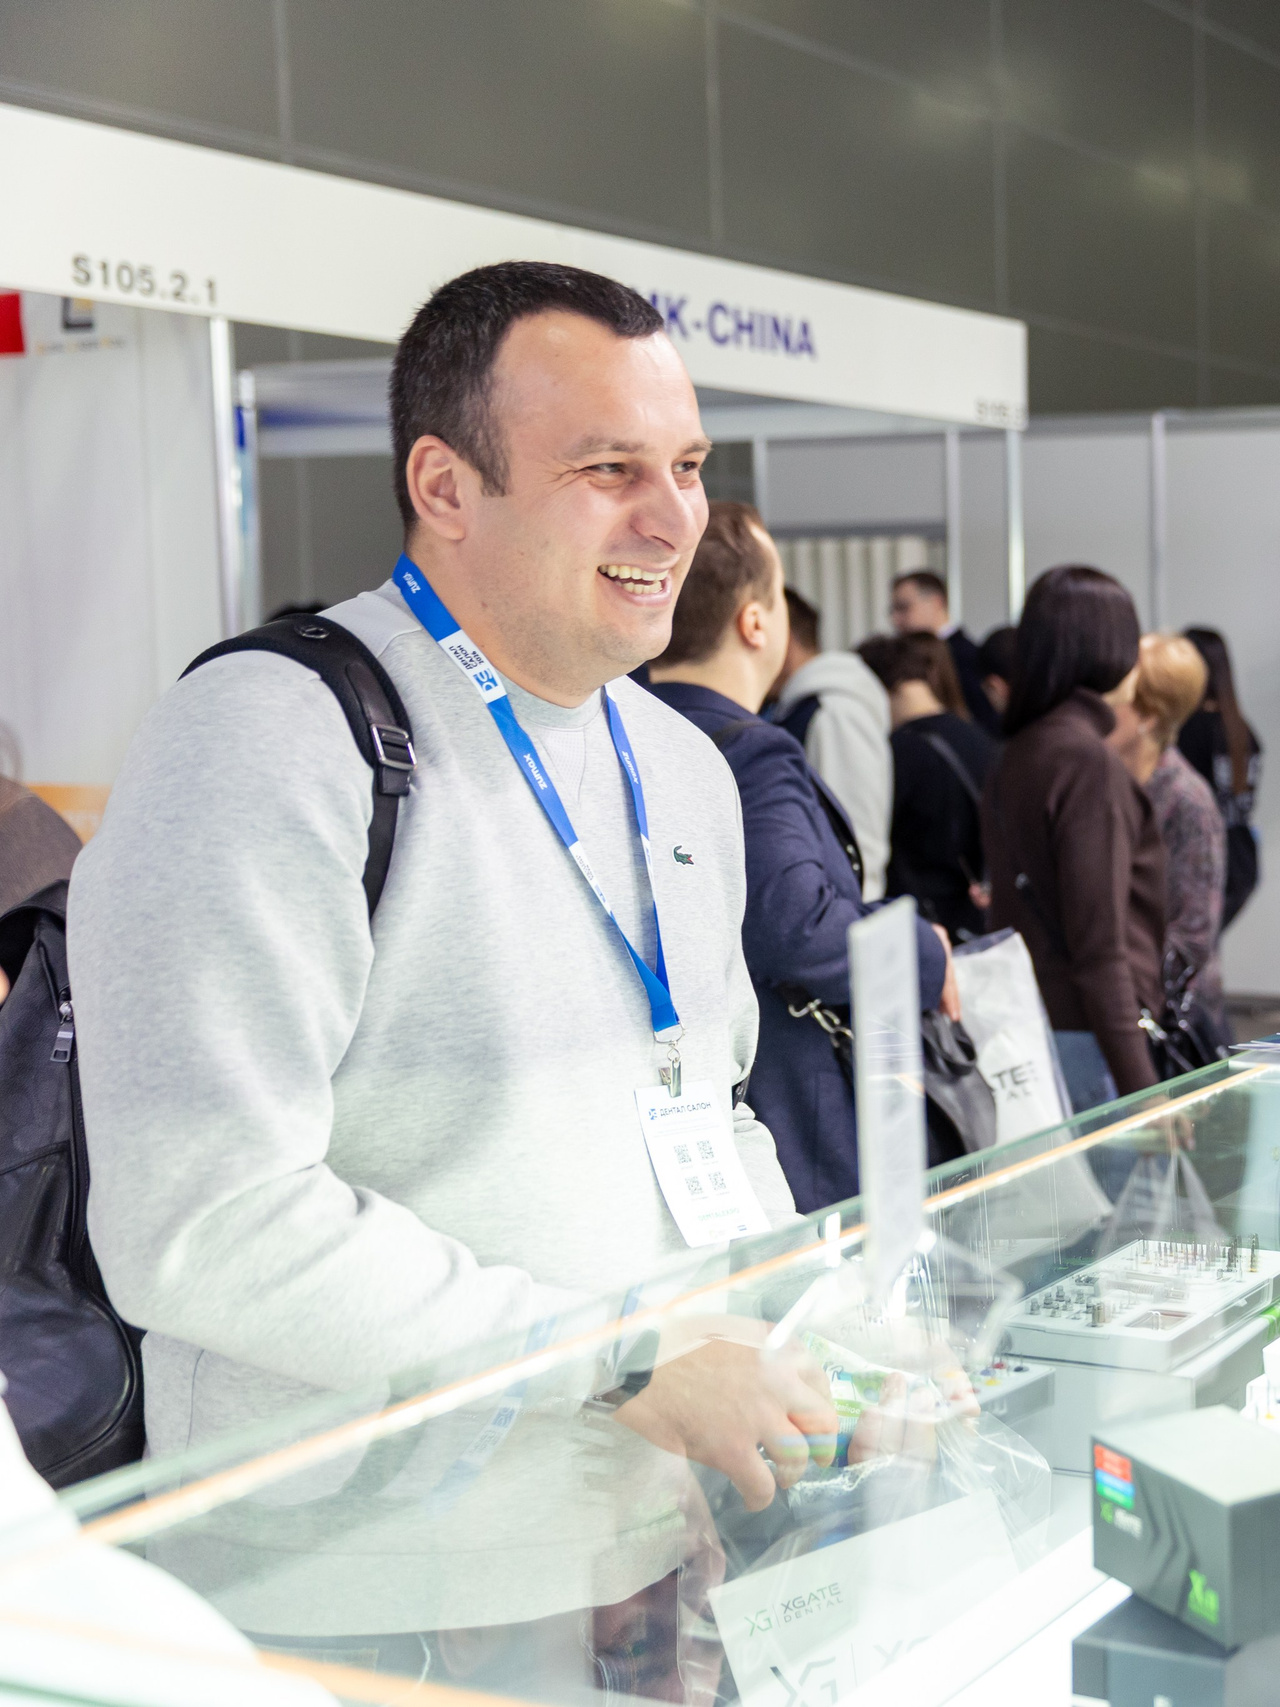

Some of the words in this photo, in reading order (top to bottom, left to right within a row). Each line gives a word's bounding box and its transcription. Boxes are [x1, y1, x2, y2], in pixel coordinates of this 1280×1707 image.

[72, 254, 217, 305] S105.2.1
[647, 288, 816, 359] K-CHINA
[660, 1106, 686, 1117] ДЕНТАЛ
[687, 1102, 712, 1112] САЛОН
[781, 1582, 841, 1614] XGATE
[783, 1597, 844, 1623] DENTAL
